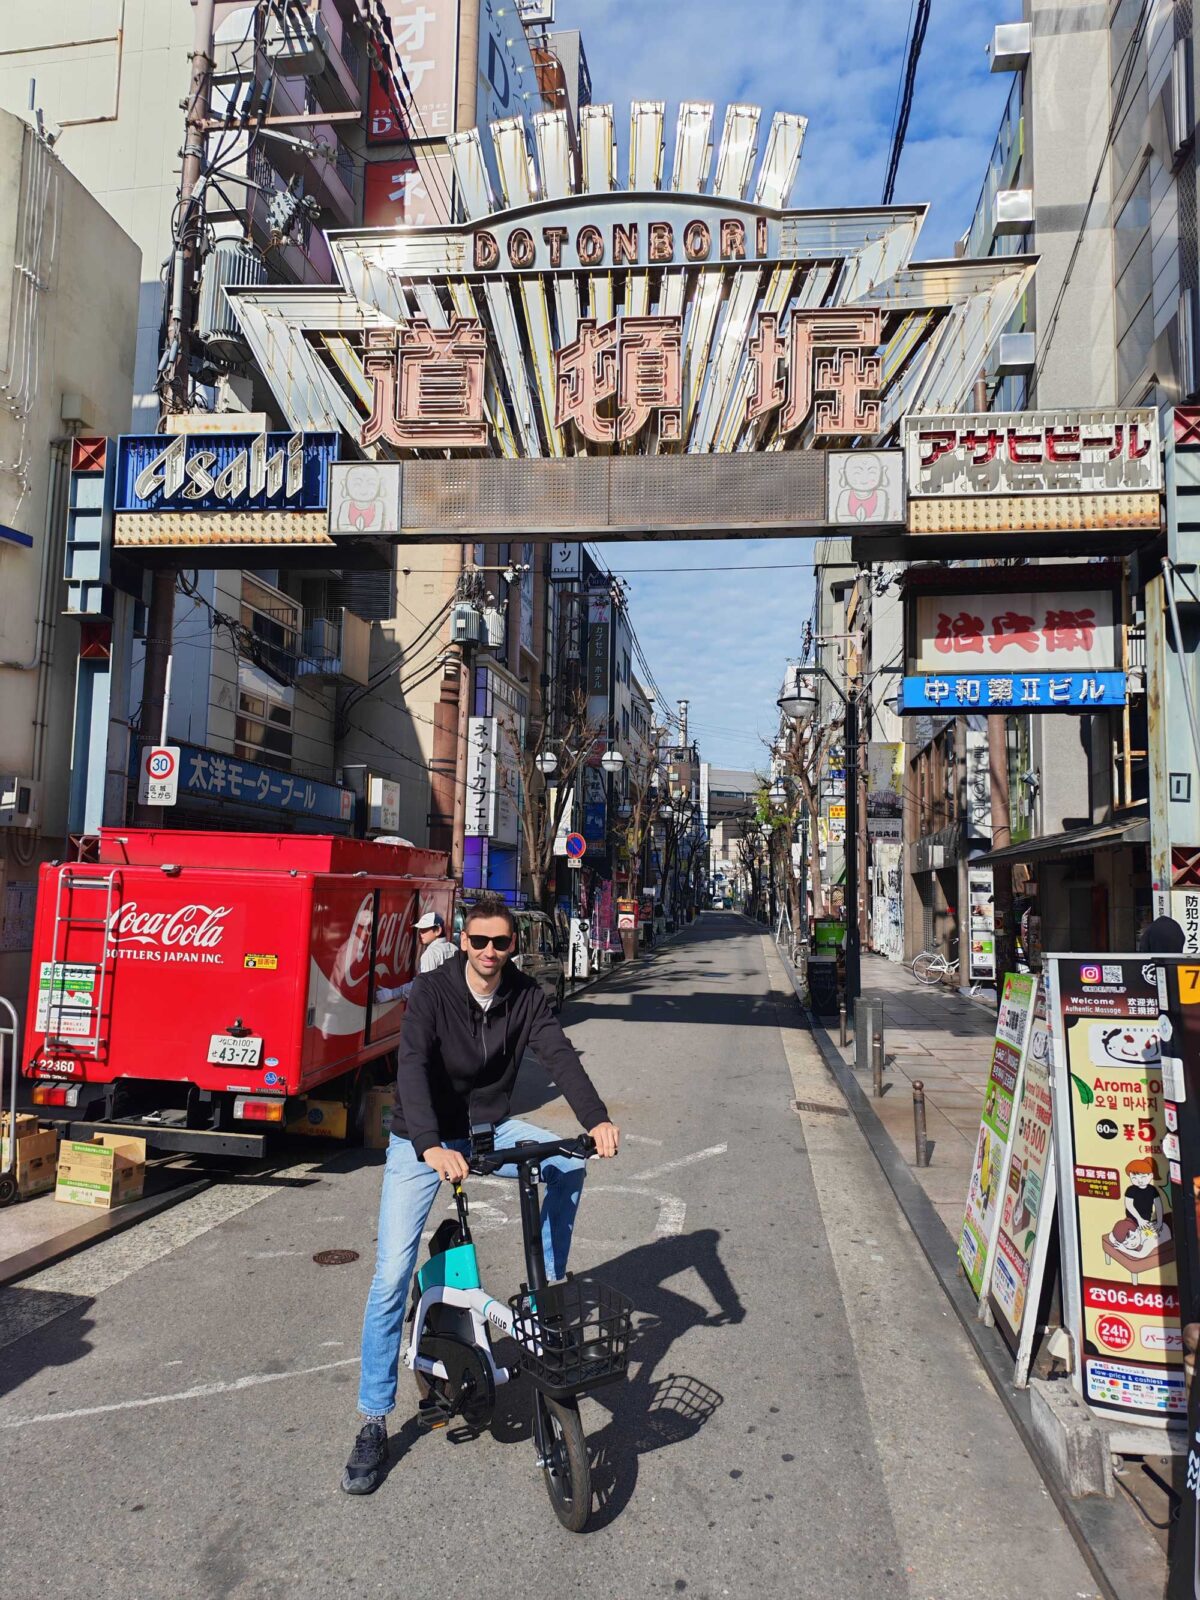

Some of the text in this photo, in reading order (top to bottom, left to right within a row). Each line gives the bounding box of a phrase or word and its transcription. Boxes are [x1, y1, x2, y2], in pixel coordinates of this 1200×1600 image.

[473, 217, 767, 269] DOTONBORI
[361, 306, 883, 450] 道頓堀
[918, 425, 1151, 468] アサヒビール
[134, 433, 304, 500] Asahi
[152, 758, 168, 771] 30
[473, 724, 489, 818] ネットカフェ
[108, 902, 233, 947] Coca-Cola
[1185, 896, 1198, 953] 防犯カメラ
[106, 949, 224, 964] BOTTLERS JAPAN INC.
[1071, 997, 1114, 1005] Welcome
[1127, 998, 1158, 1006] 欢迎光
[219, 1047, 257, 1063] 43-72
[1094, 1077, 1142, 1092] Aroma
[1095, 1095, 1158, 1112] 오일 마사지
[1101, 1323, 1128, 1339] 24h
[1094, 1370, 1126, 1380] low-price
[1134, 1376, 1163, 1385] cashless
